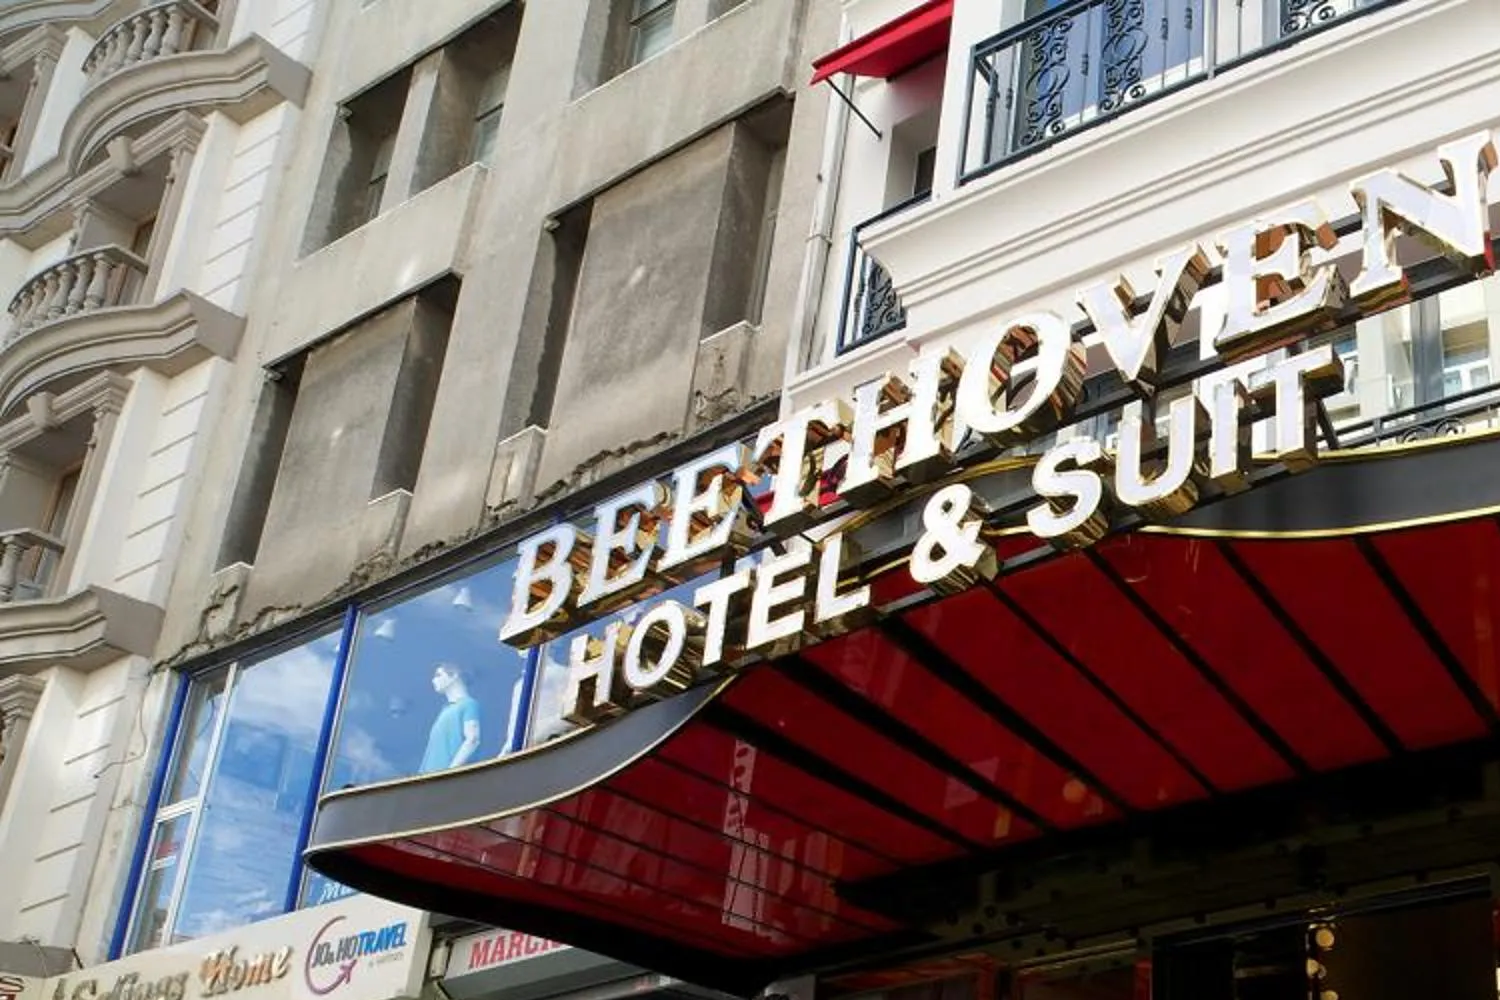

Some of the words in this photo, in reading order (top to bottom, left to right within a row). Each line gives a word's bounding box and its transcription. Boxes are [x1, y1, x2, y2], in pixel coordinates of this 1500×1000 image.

[499, 130, 1496, 646] BEETHOVEN
[562, 530, 871, 722] HOTEL
[908, 483, 986, 584] &
[1026, 344, 1338, 540] SUIT
[199, 944, 295, 998] Home
